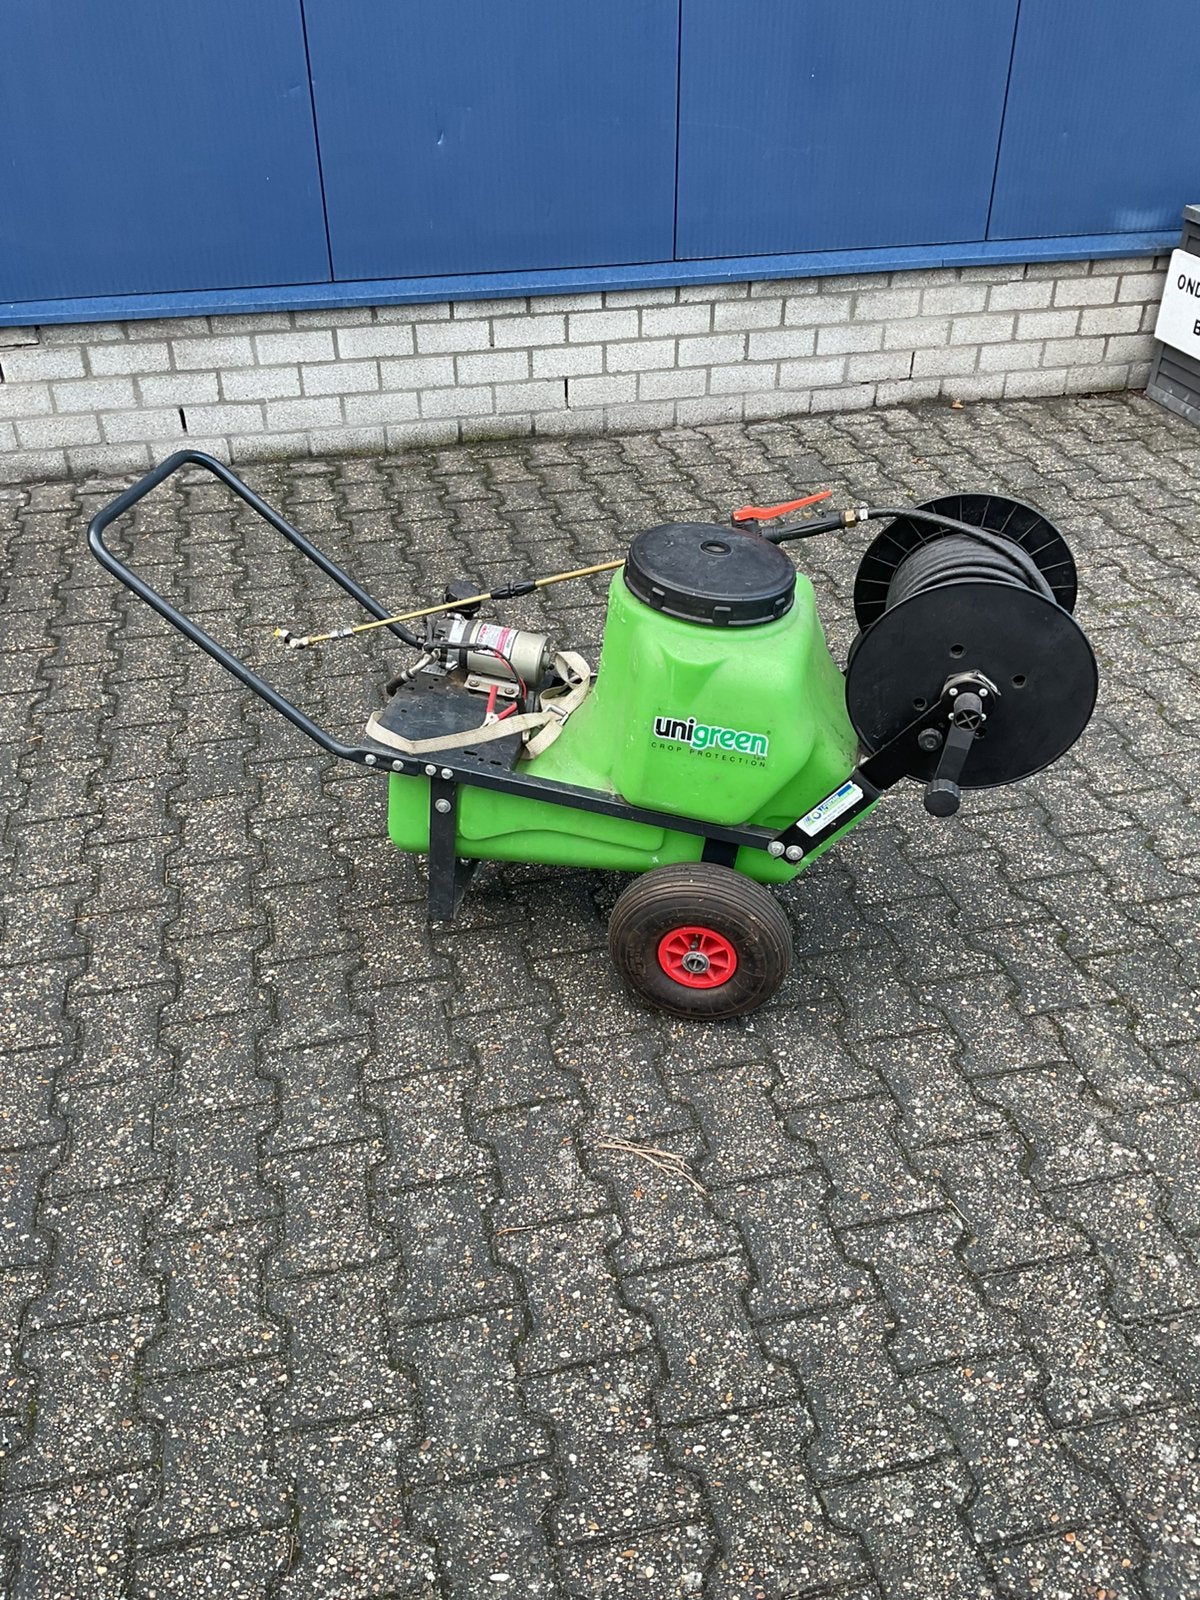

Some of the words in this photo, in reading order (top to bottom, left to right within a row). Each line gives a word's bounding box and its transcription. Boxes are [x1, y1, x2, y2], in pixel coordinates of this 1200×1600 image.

[655, 717, 768, 754] unigreen
[651, 742, 682, 752] CROP
[689, 748, 766, 768] PROTECTION
